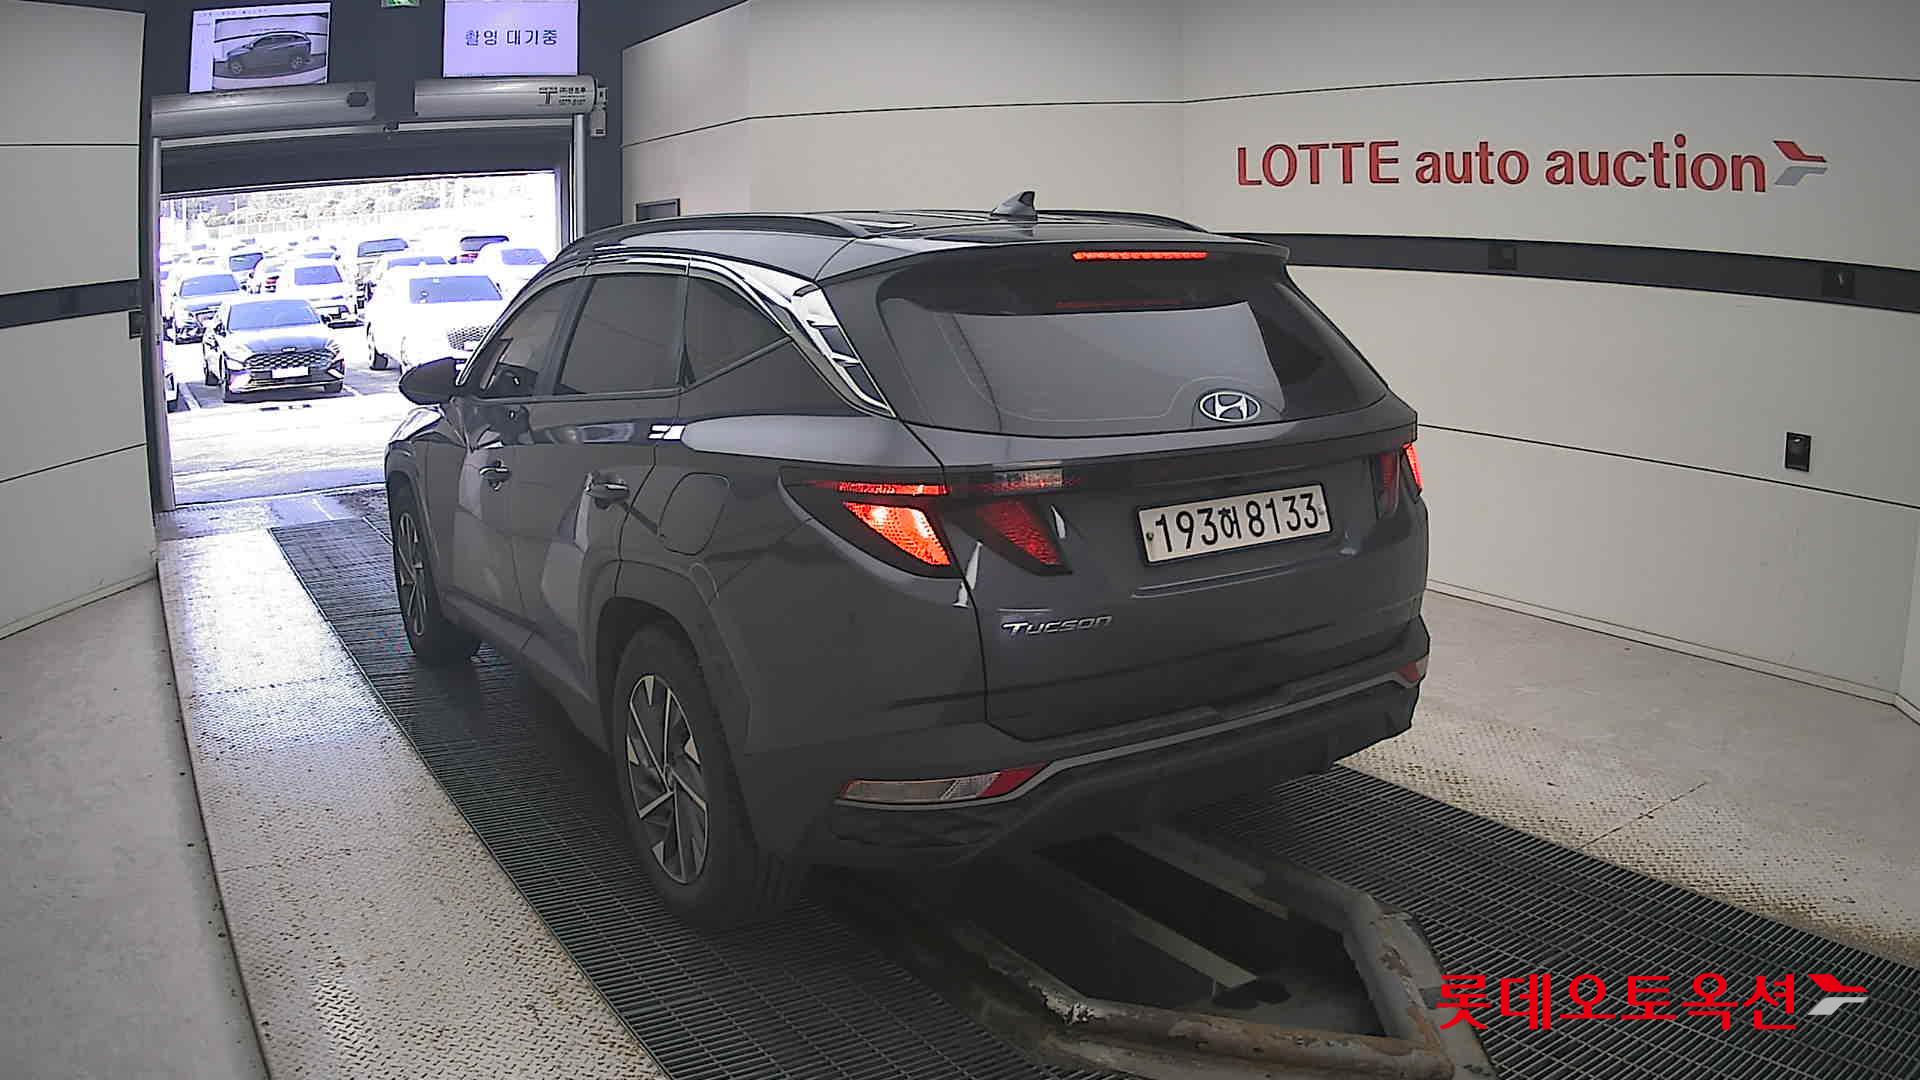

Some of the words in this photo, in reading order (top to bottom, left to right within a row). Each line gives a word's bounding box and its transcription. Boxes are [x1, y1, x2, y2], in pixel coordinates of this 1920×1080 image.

[1237, 140, 1400, 187] LOTTE
[1415, 141, 1529, 185] auto
[1544, 133, 1767, 193] auction
